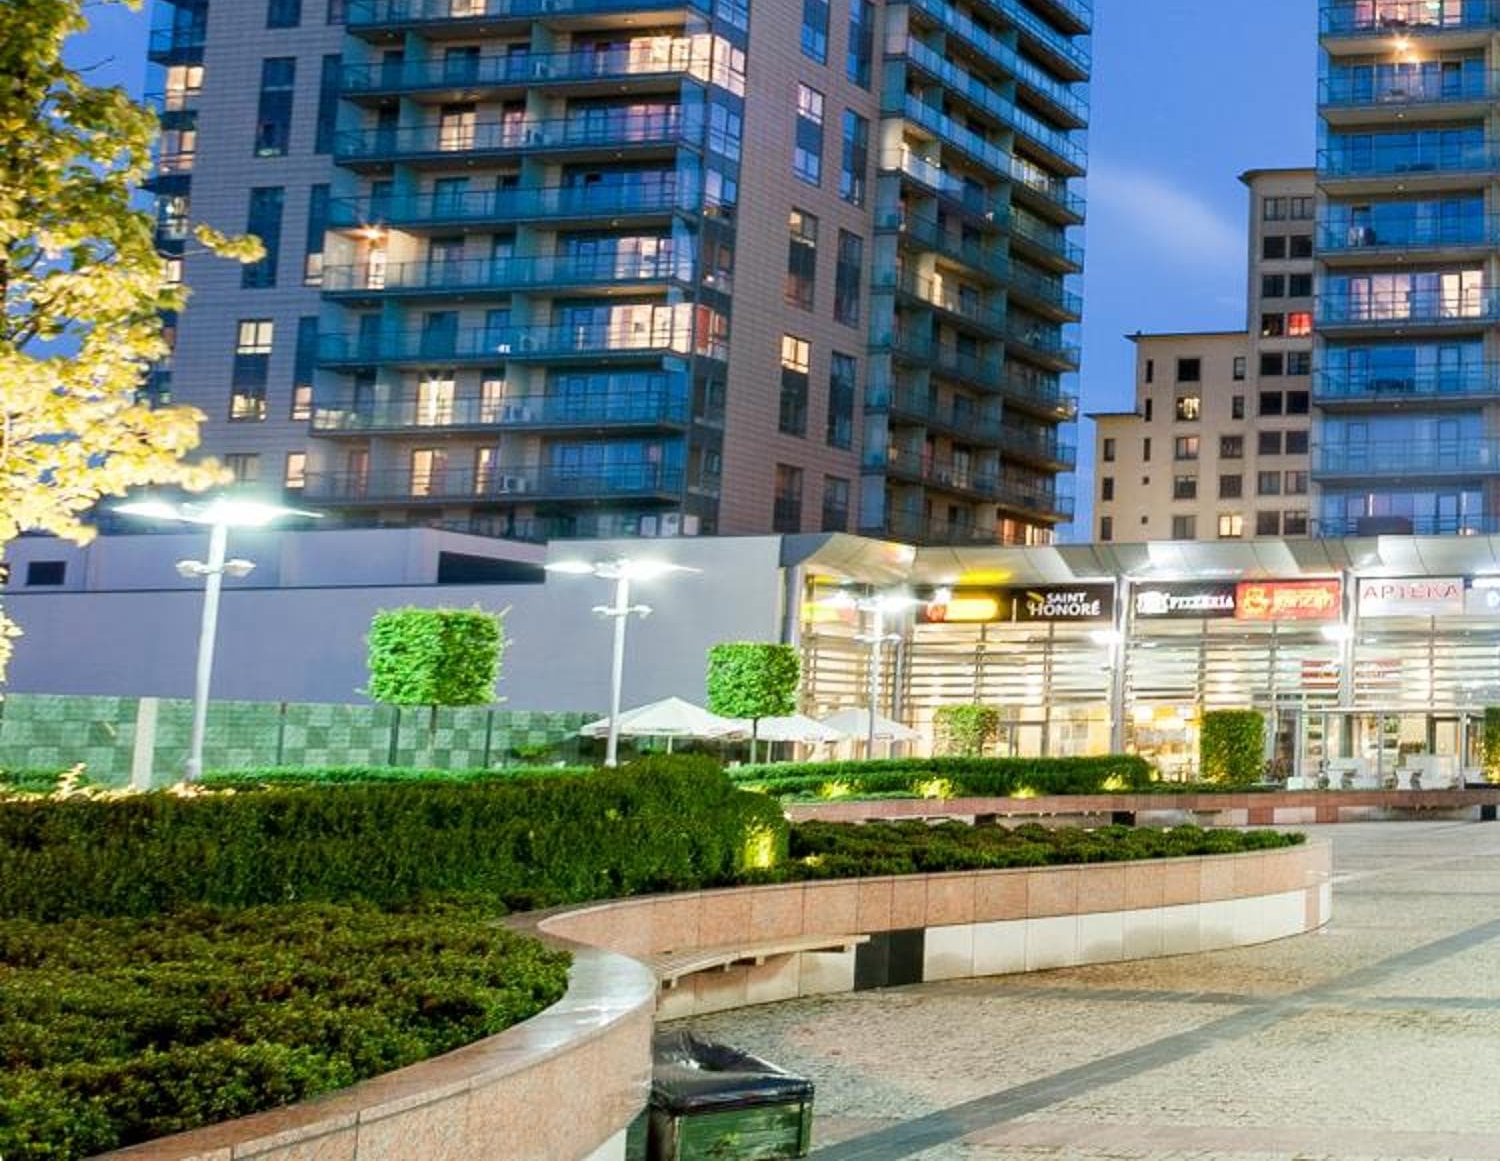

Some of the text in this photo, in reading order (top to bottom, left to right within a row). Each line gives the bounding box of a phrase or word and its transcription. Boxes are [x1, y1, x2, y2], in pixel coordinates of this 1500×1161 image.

[1046, 592, 1087, 603] SAINT
[1363, 584, 1458, 600] APTEKA
[1027, 599, 1101, 616] HONORÉ
